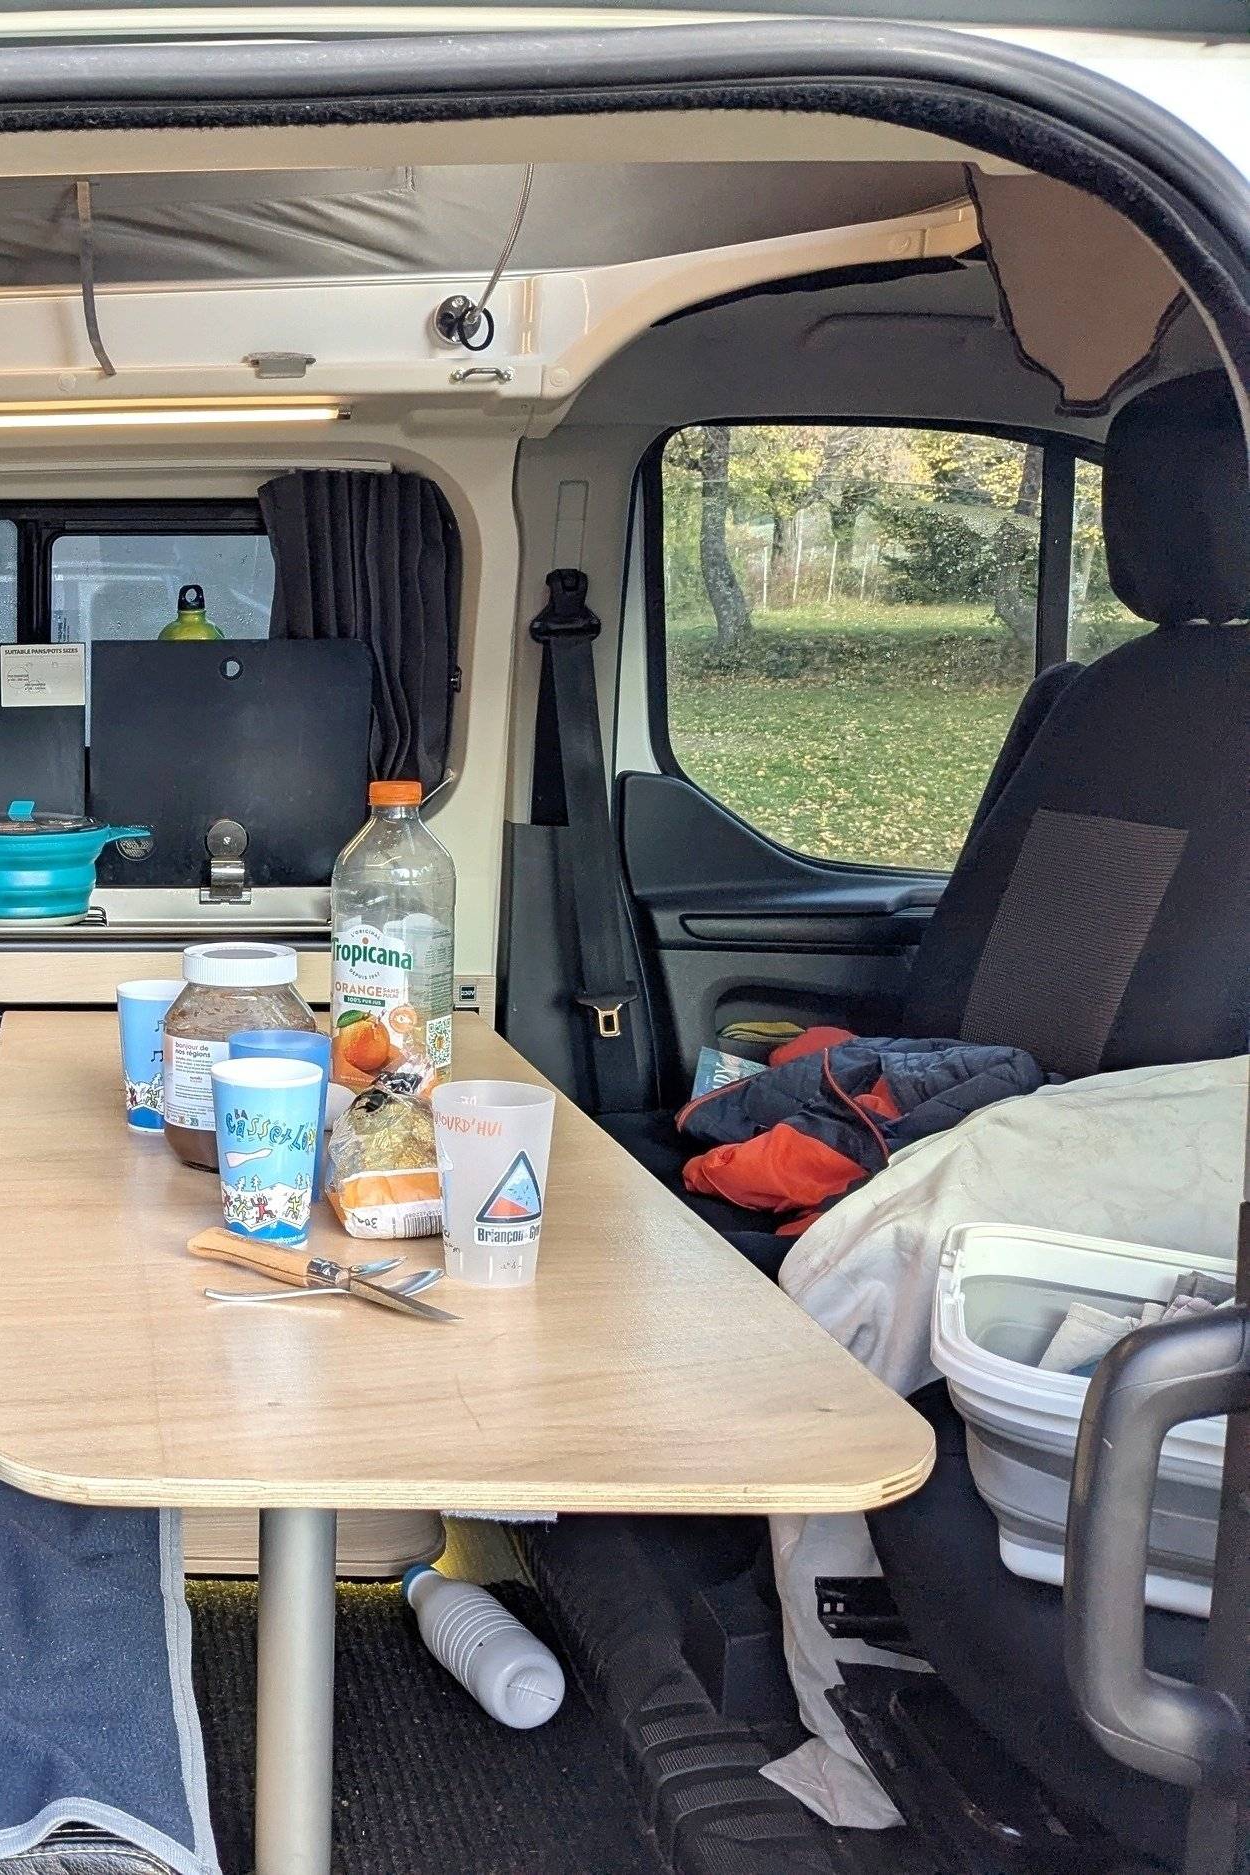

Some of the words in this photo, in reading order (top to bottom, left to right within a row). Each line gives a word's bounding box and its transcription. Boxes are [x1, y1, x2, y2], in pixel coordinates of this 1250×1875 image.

[31, 647, 62, 655] PANS/POTS
[332, 936, 412, 971] Tropicana
[335, 981, 383, 997] ORANGE
[346, 996, 362, 1004] 100%
[175, 1041, 199, 1051] bonjour
[186, 1050, 211, 1059] régions
[477, 1227, 524, 1245] Briançon
